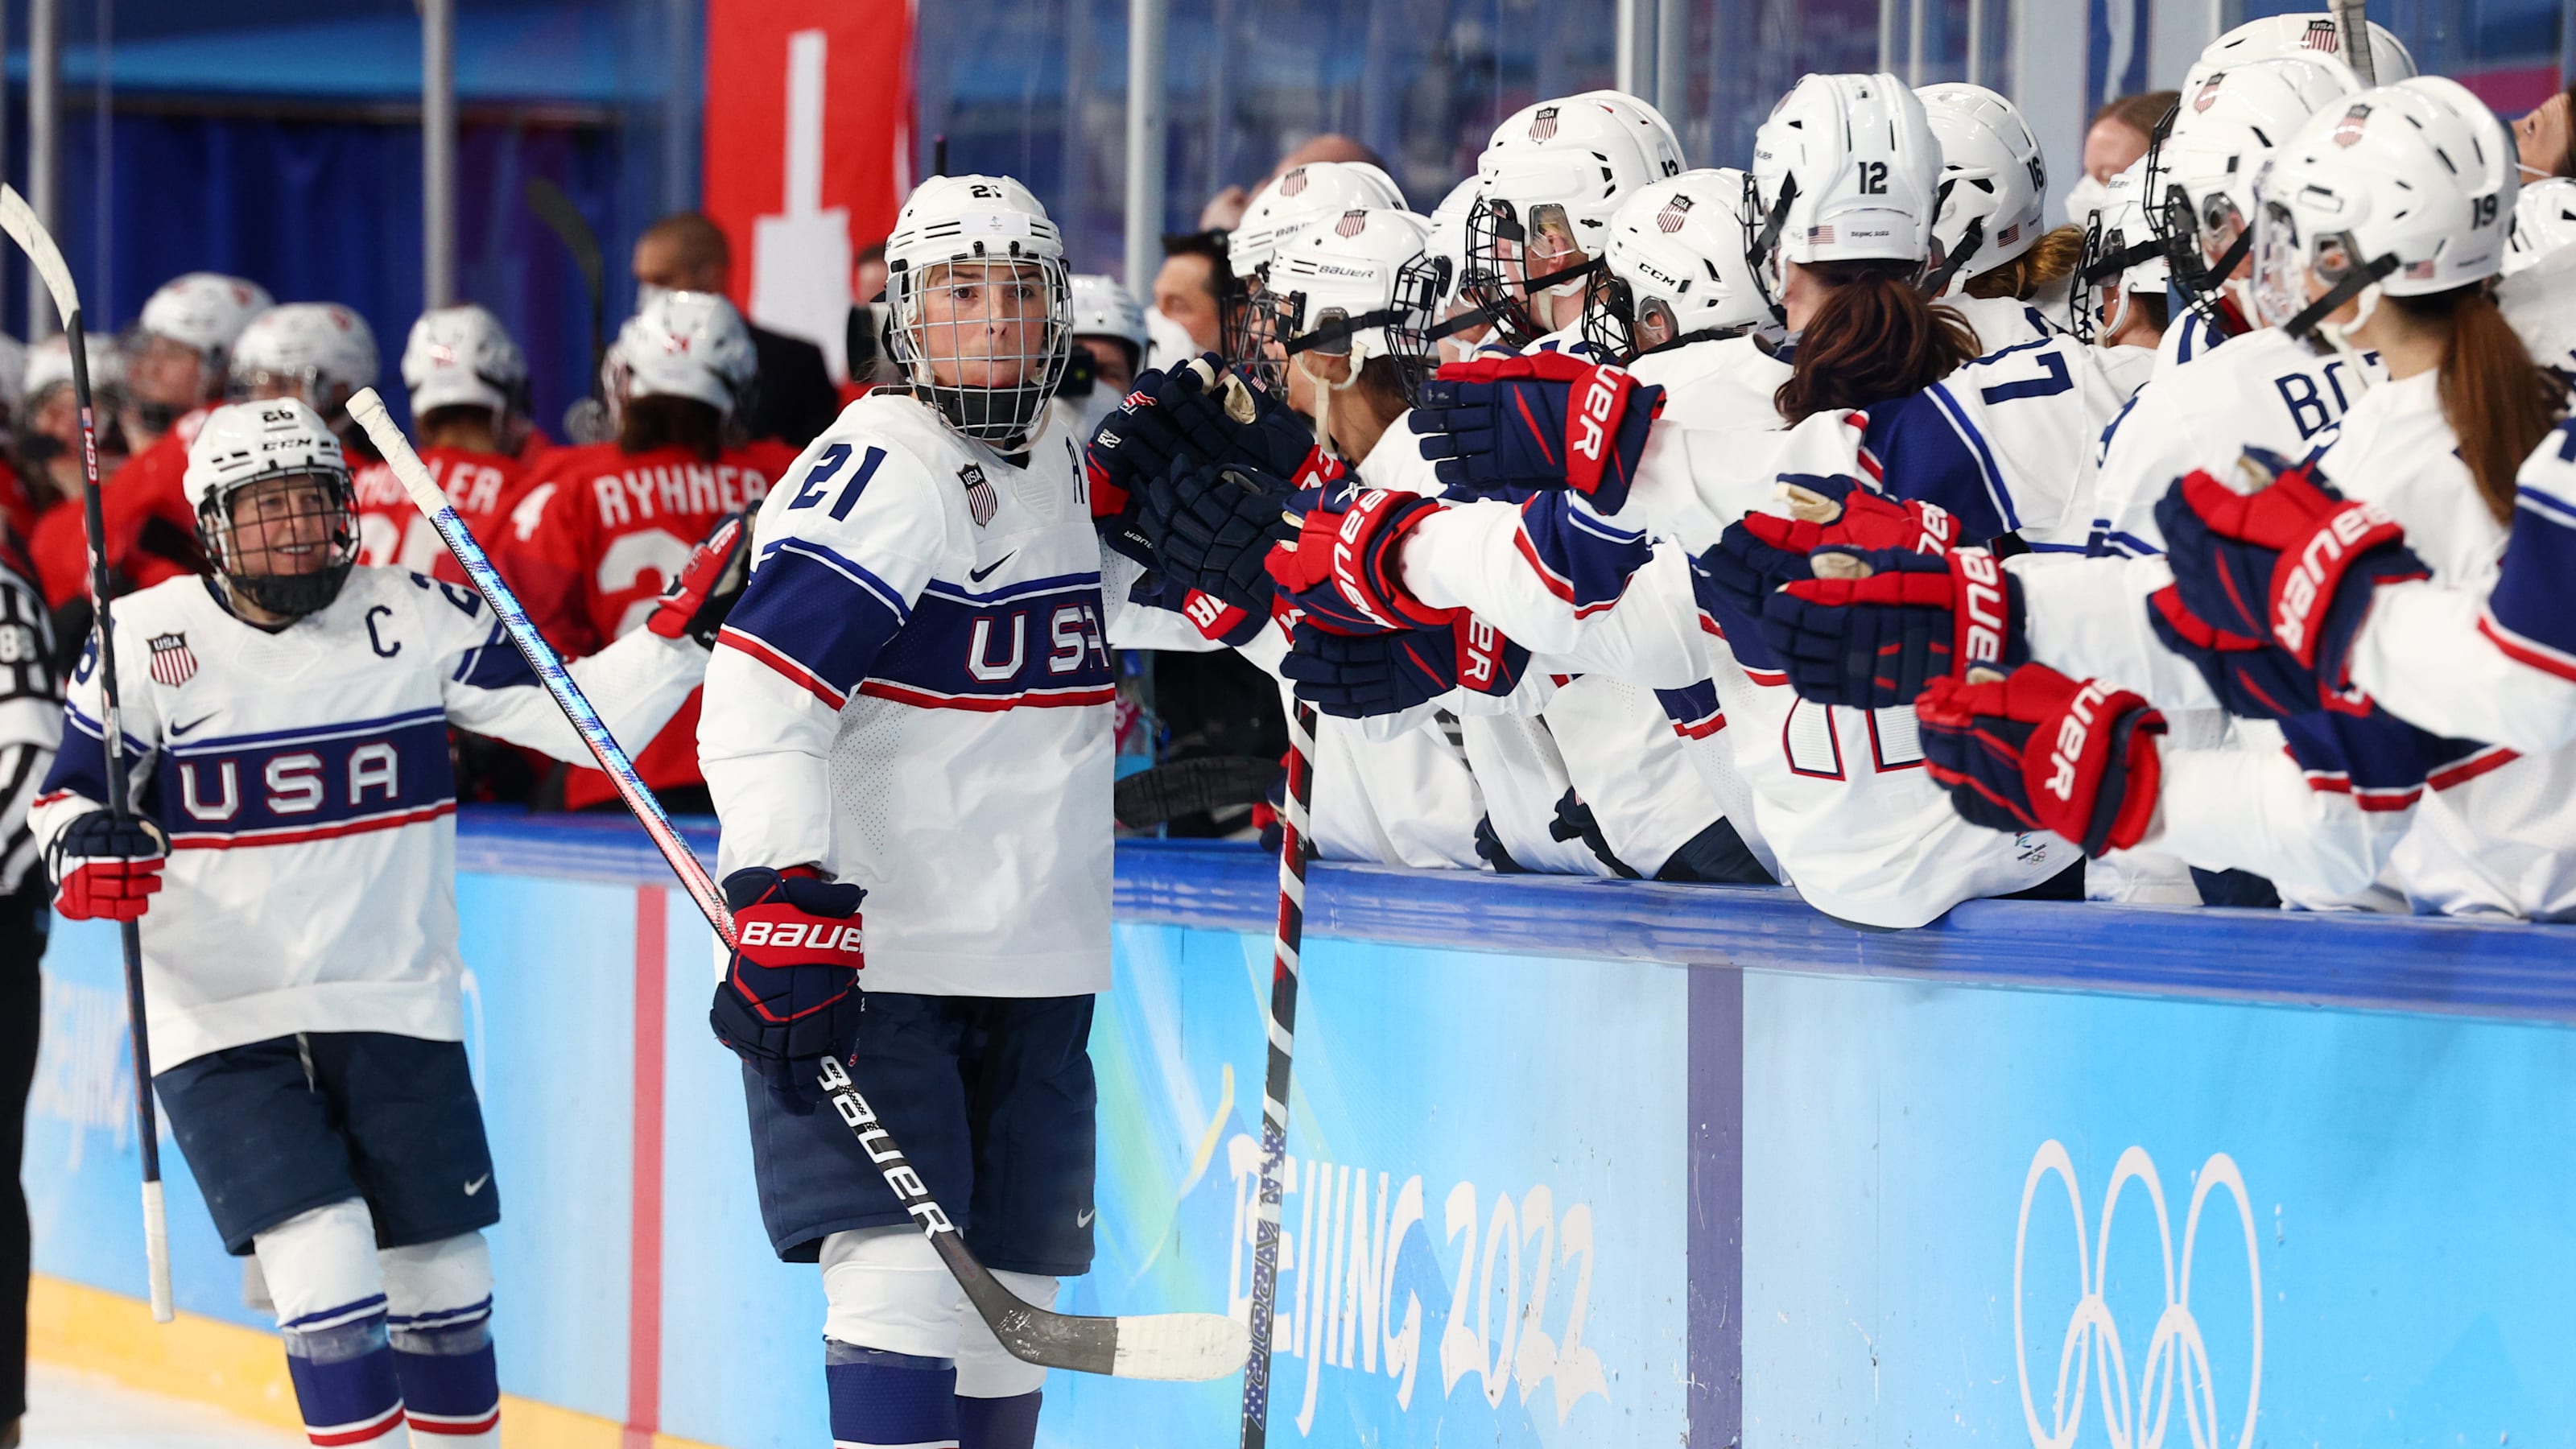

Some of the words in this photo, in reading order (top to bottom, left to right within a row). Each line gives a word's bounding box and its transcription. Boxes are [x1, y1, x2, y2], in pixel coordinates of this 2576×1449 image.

[1538, 109, 1554, 120] USA
[969, 184, 1003, 198] 21
[1858, 161, 1888, 195] 12
[2028, 155, 2045, 193] 16
[1671, 195, 1691, 210] USA
[2471, 193, 2496, 230] 19
[1637, 261, 1678, 287] CCM
[86, 433, 98, 482] CCM
[262, 438, 312, 455] CCM
[788, 443, 888, 522] 21
[963, 469, 983, 485] USA
[1065, 436, 1086, 506] A
[152, 635, 183, 652] USA
[365, 605, 401, 658] C
[967, 604, 1112, 684] USA
[179, 741, 400, 821] USA
[740, 921, 863, 954] BAUE
[1228, 1133, 1424, 1438] BEIJING
[1439, 1179, 1612, 1427] 2022
